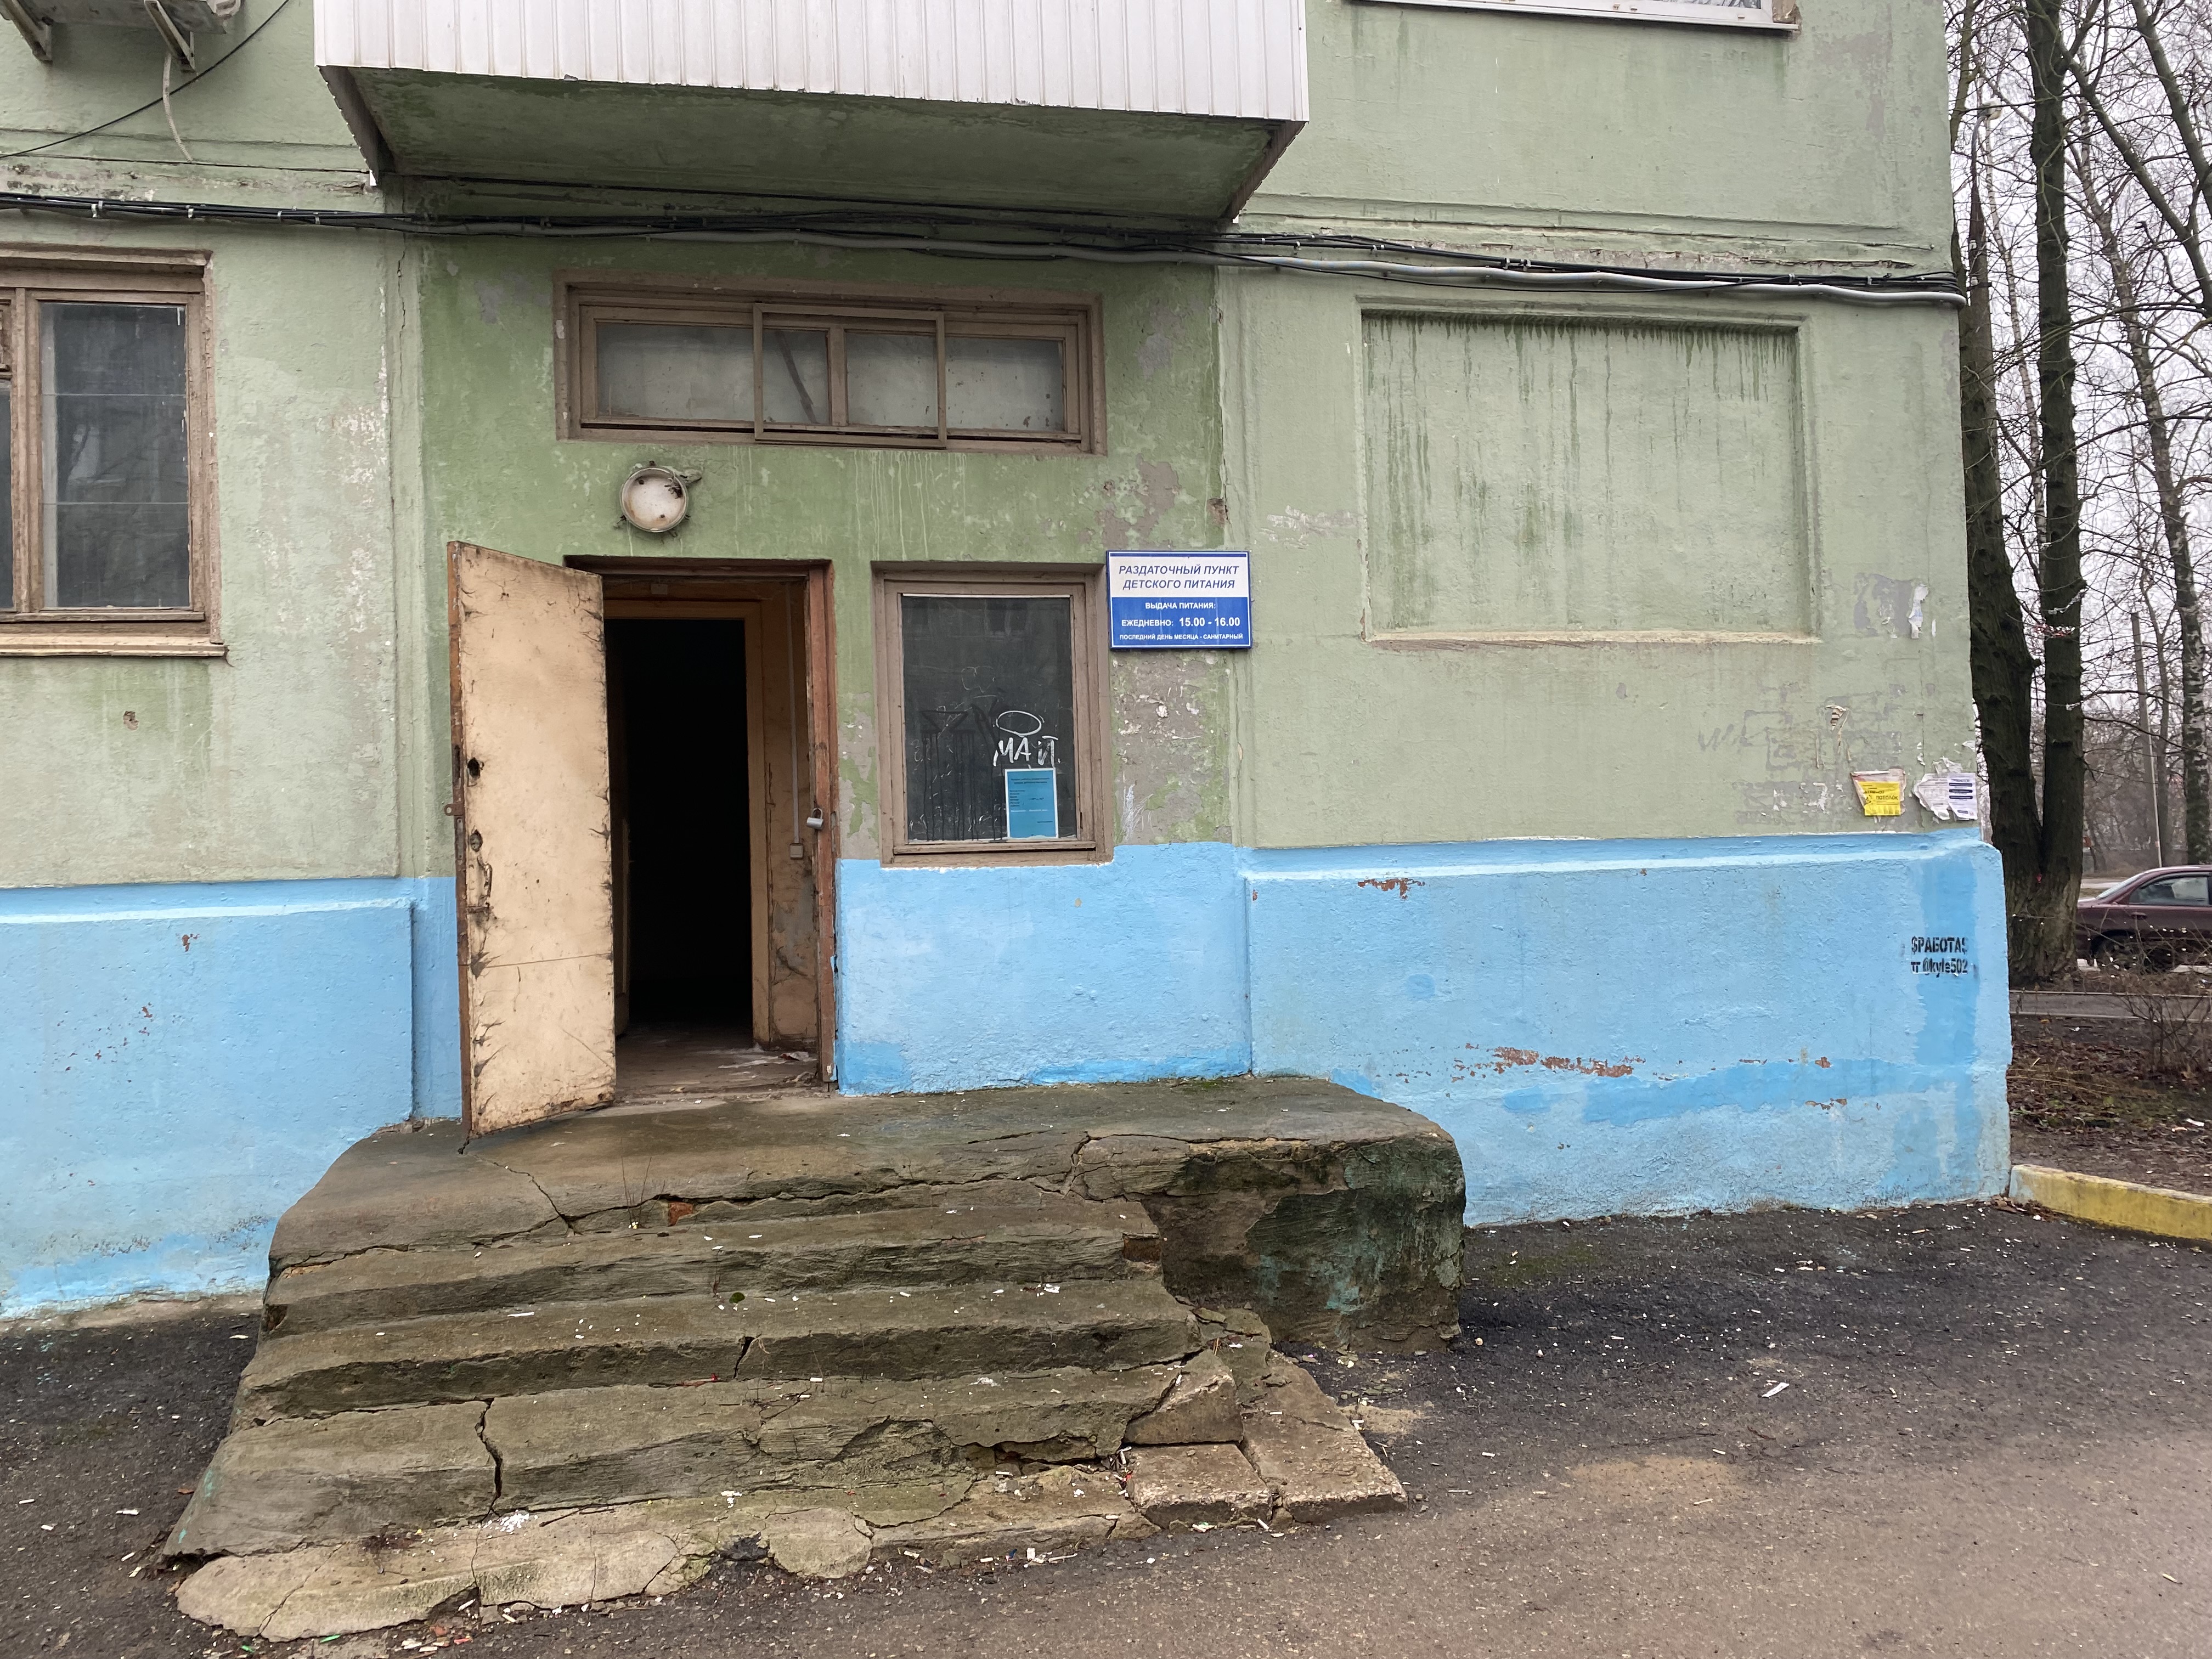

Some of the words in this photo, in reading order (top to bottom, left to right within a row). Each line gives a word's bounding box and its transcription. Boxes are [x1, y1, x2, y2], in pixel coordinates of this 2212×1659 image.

[1119, 563, 1201, 575] РАЗДАТОЧНЫЙ
[1204, 566, 1239, 574] ПУНКТ
[1122, 580, 1181, 590] ДЕТСКОГО
[1184, 580, 1235, 589] ПИТАНИЯ
[1121, 619, 1174, 628] ЕЖЕДНЕВНО:
[1179, 617, 1205, 627] 15.00
[1214, 617, 1240, 627] 16.00
[1923, 958, 1968, 978] @kyle502
